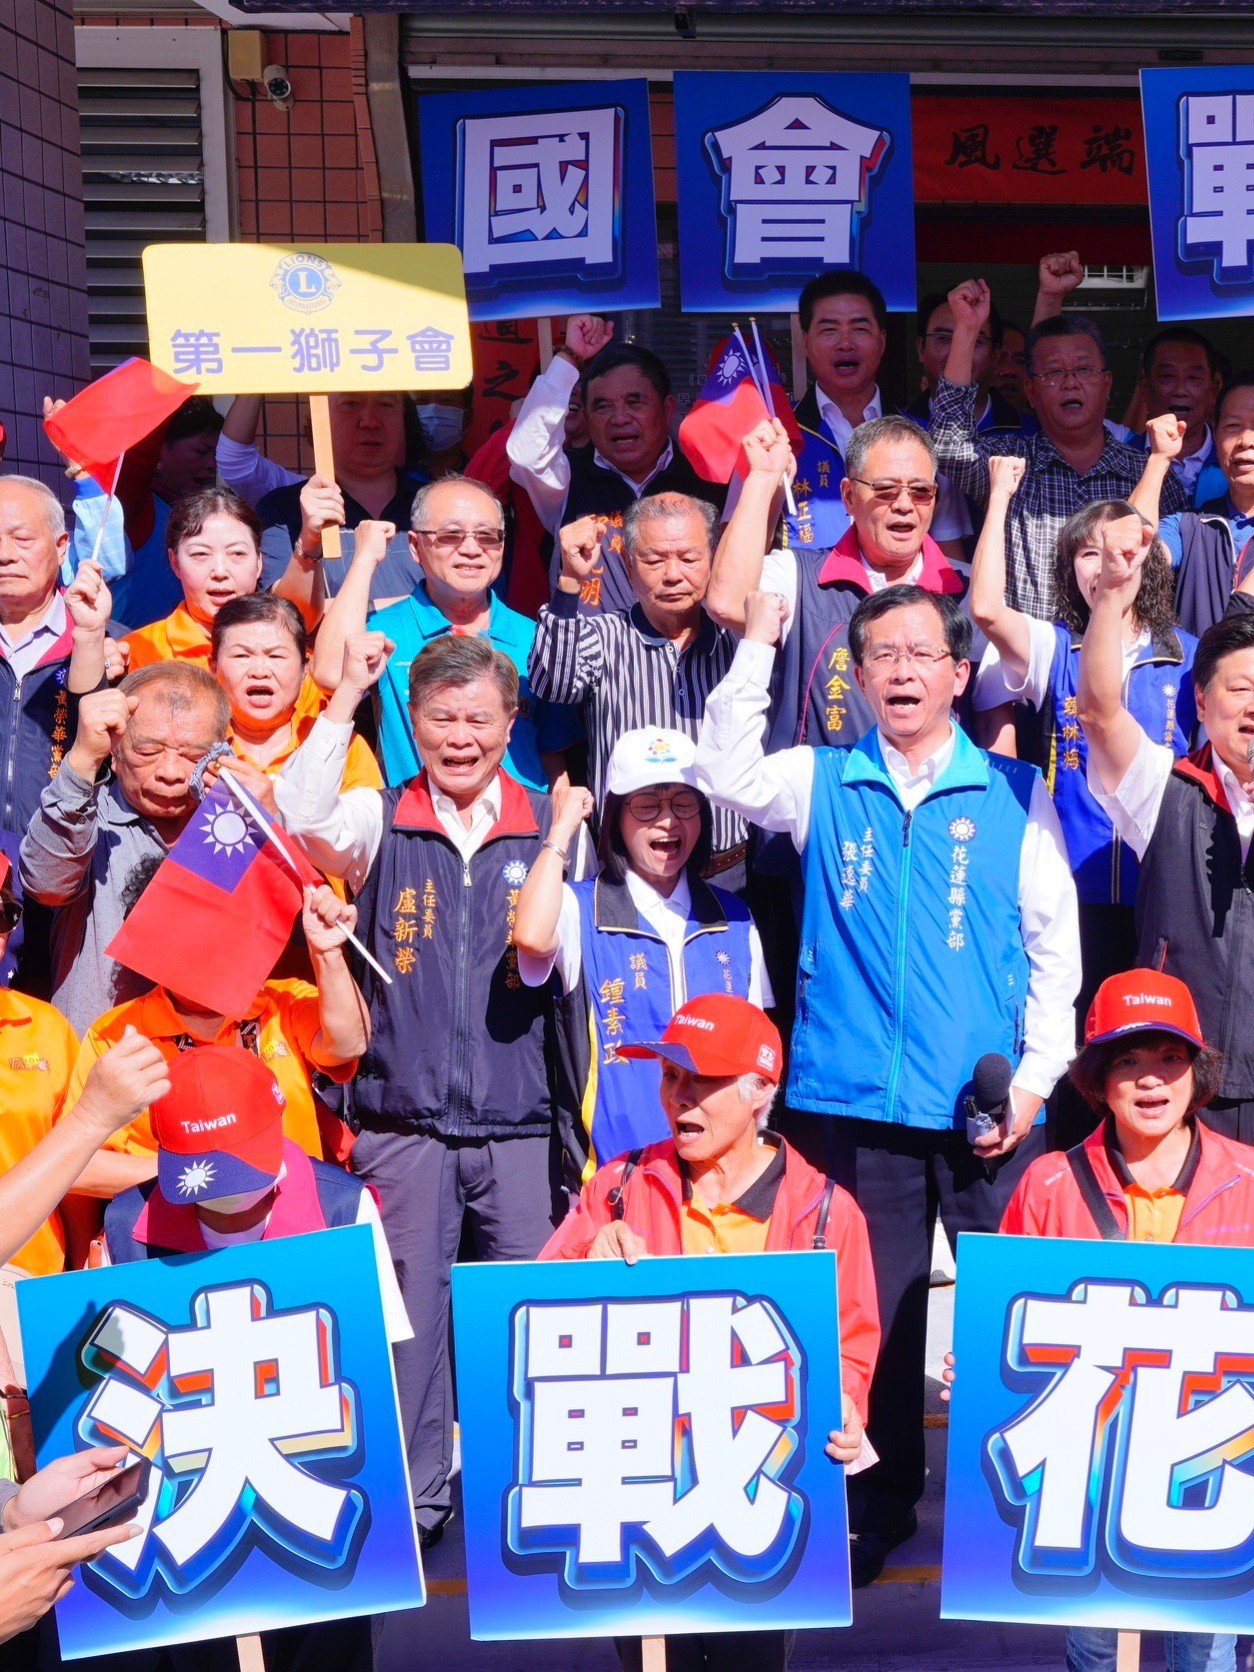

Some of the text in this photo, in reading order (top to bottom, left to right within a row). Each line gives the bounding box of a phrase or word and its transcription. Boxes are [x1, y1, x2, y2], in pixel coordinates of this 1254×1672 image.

[463, 107, 617, 274] 國
[713, 97, 885, 264] 會
[284, 254, 327, 268] LIONS
[297, 271, 317, 293] L
[170, 326, 456, 376] 第一獅子會
[825, 647, 852, 732] 詹金富
[859, 827, 875, 894] 主任委員
[422, 879, 437, 939] 主任委員
[946, 845, 970, 952] 花蓮縣黨部
[394, 887, 419, 974] 盧新榮
[629, 952, 649, 990] 議員
[723, 961, 734, 995] 花蓮
[1123, 992, 1173, 1007] Taiwan
[674, 1014, 715, 1032] Taiwan
[181, 1112, 237, 1134] Taiwan
[90, 1286, 354, 1571] 決
[520, 1297, 790, 1563] 戰
